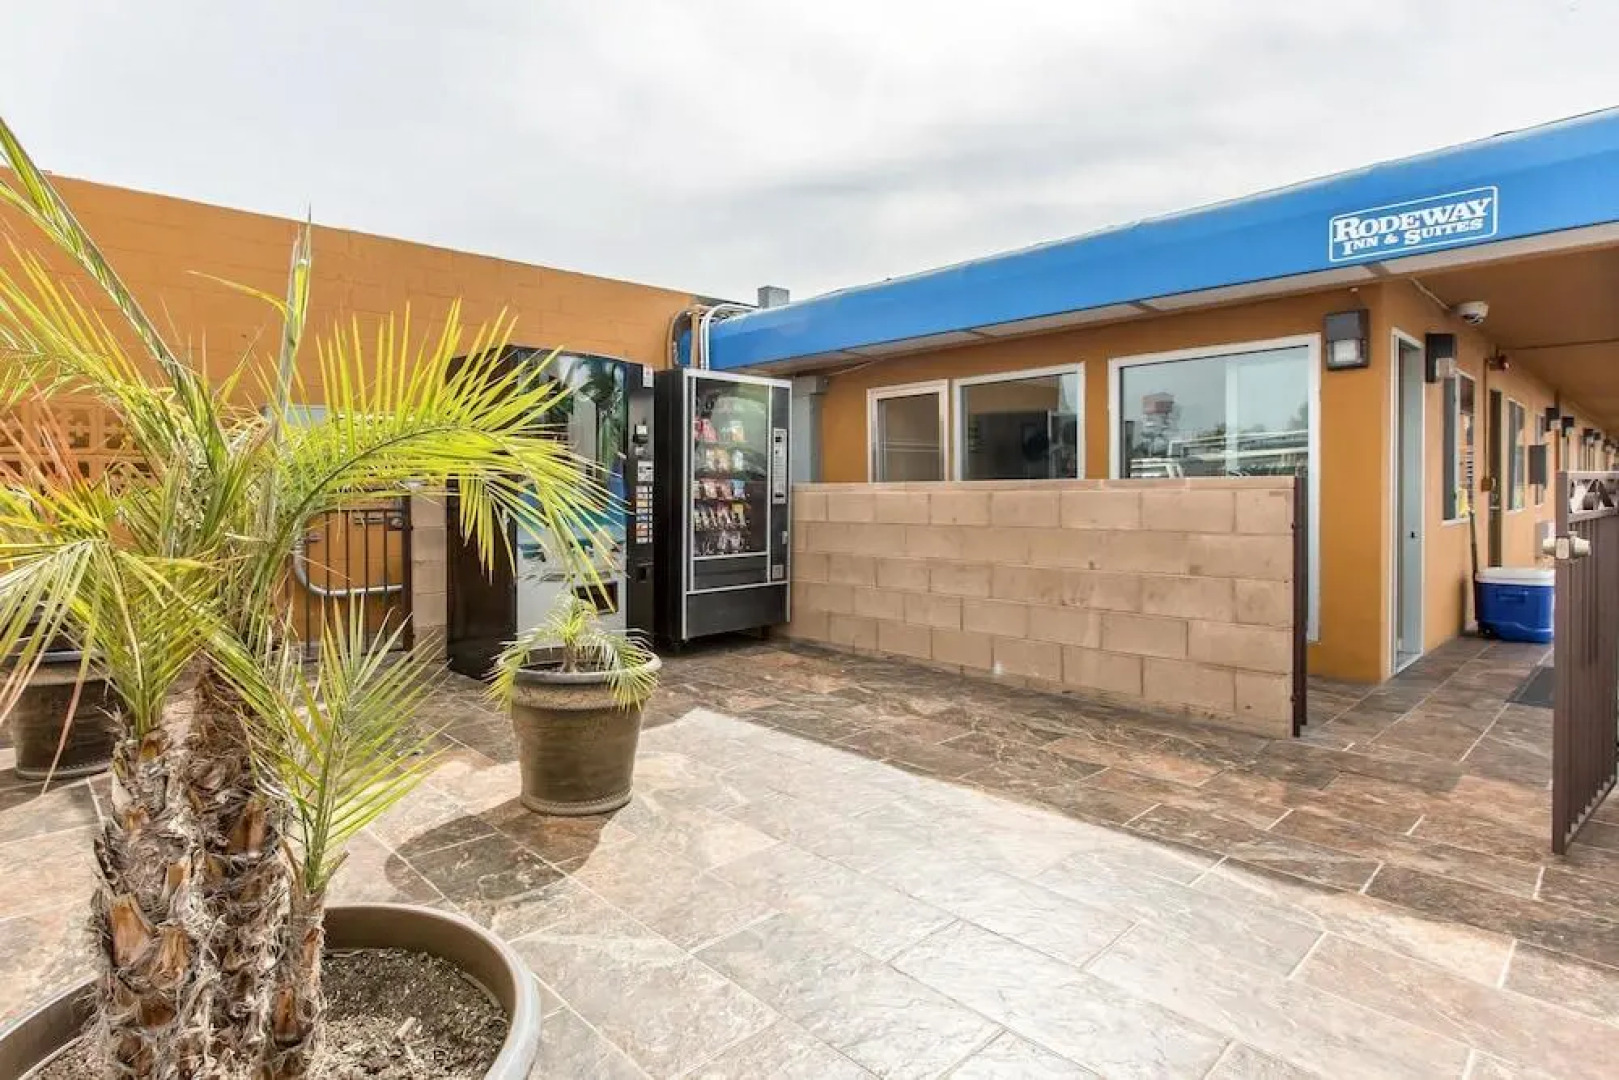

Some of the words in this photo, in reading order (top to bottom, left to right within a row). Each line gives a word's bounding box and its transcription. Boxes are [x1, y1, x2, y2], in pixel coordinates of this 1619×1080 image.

[1334, 197, 1492, 242] RODEWAY
[1342, 235, 1378, 255] INN
[1384, 232, 1399, 245] &
[1404, 218, 1484, 245] SUITES
